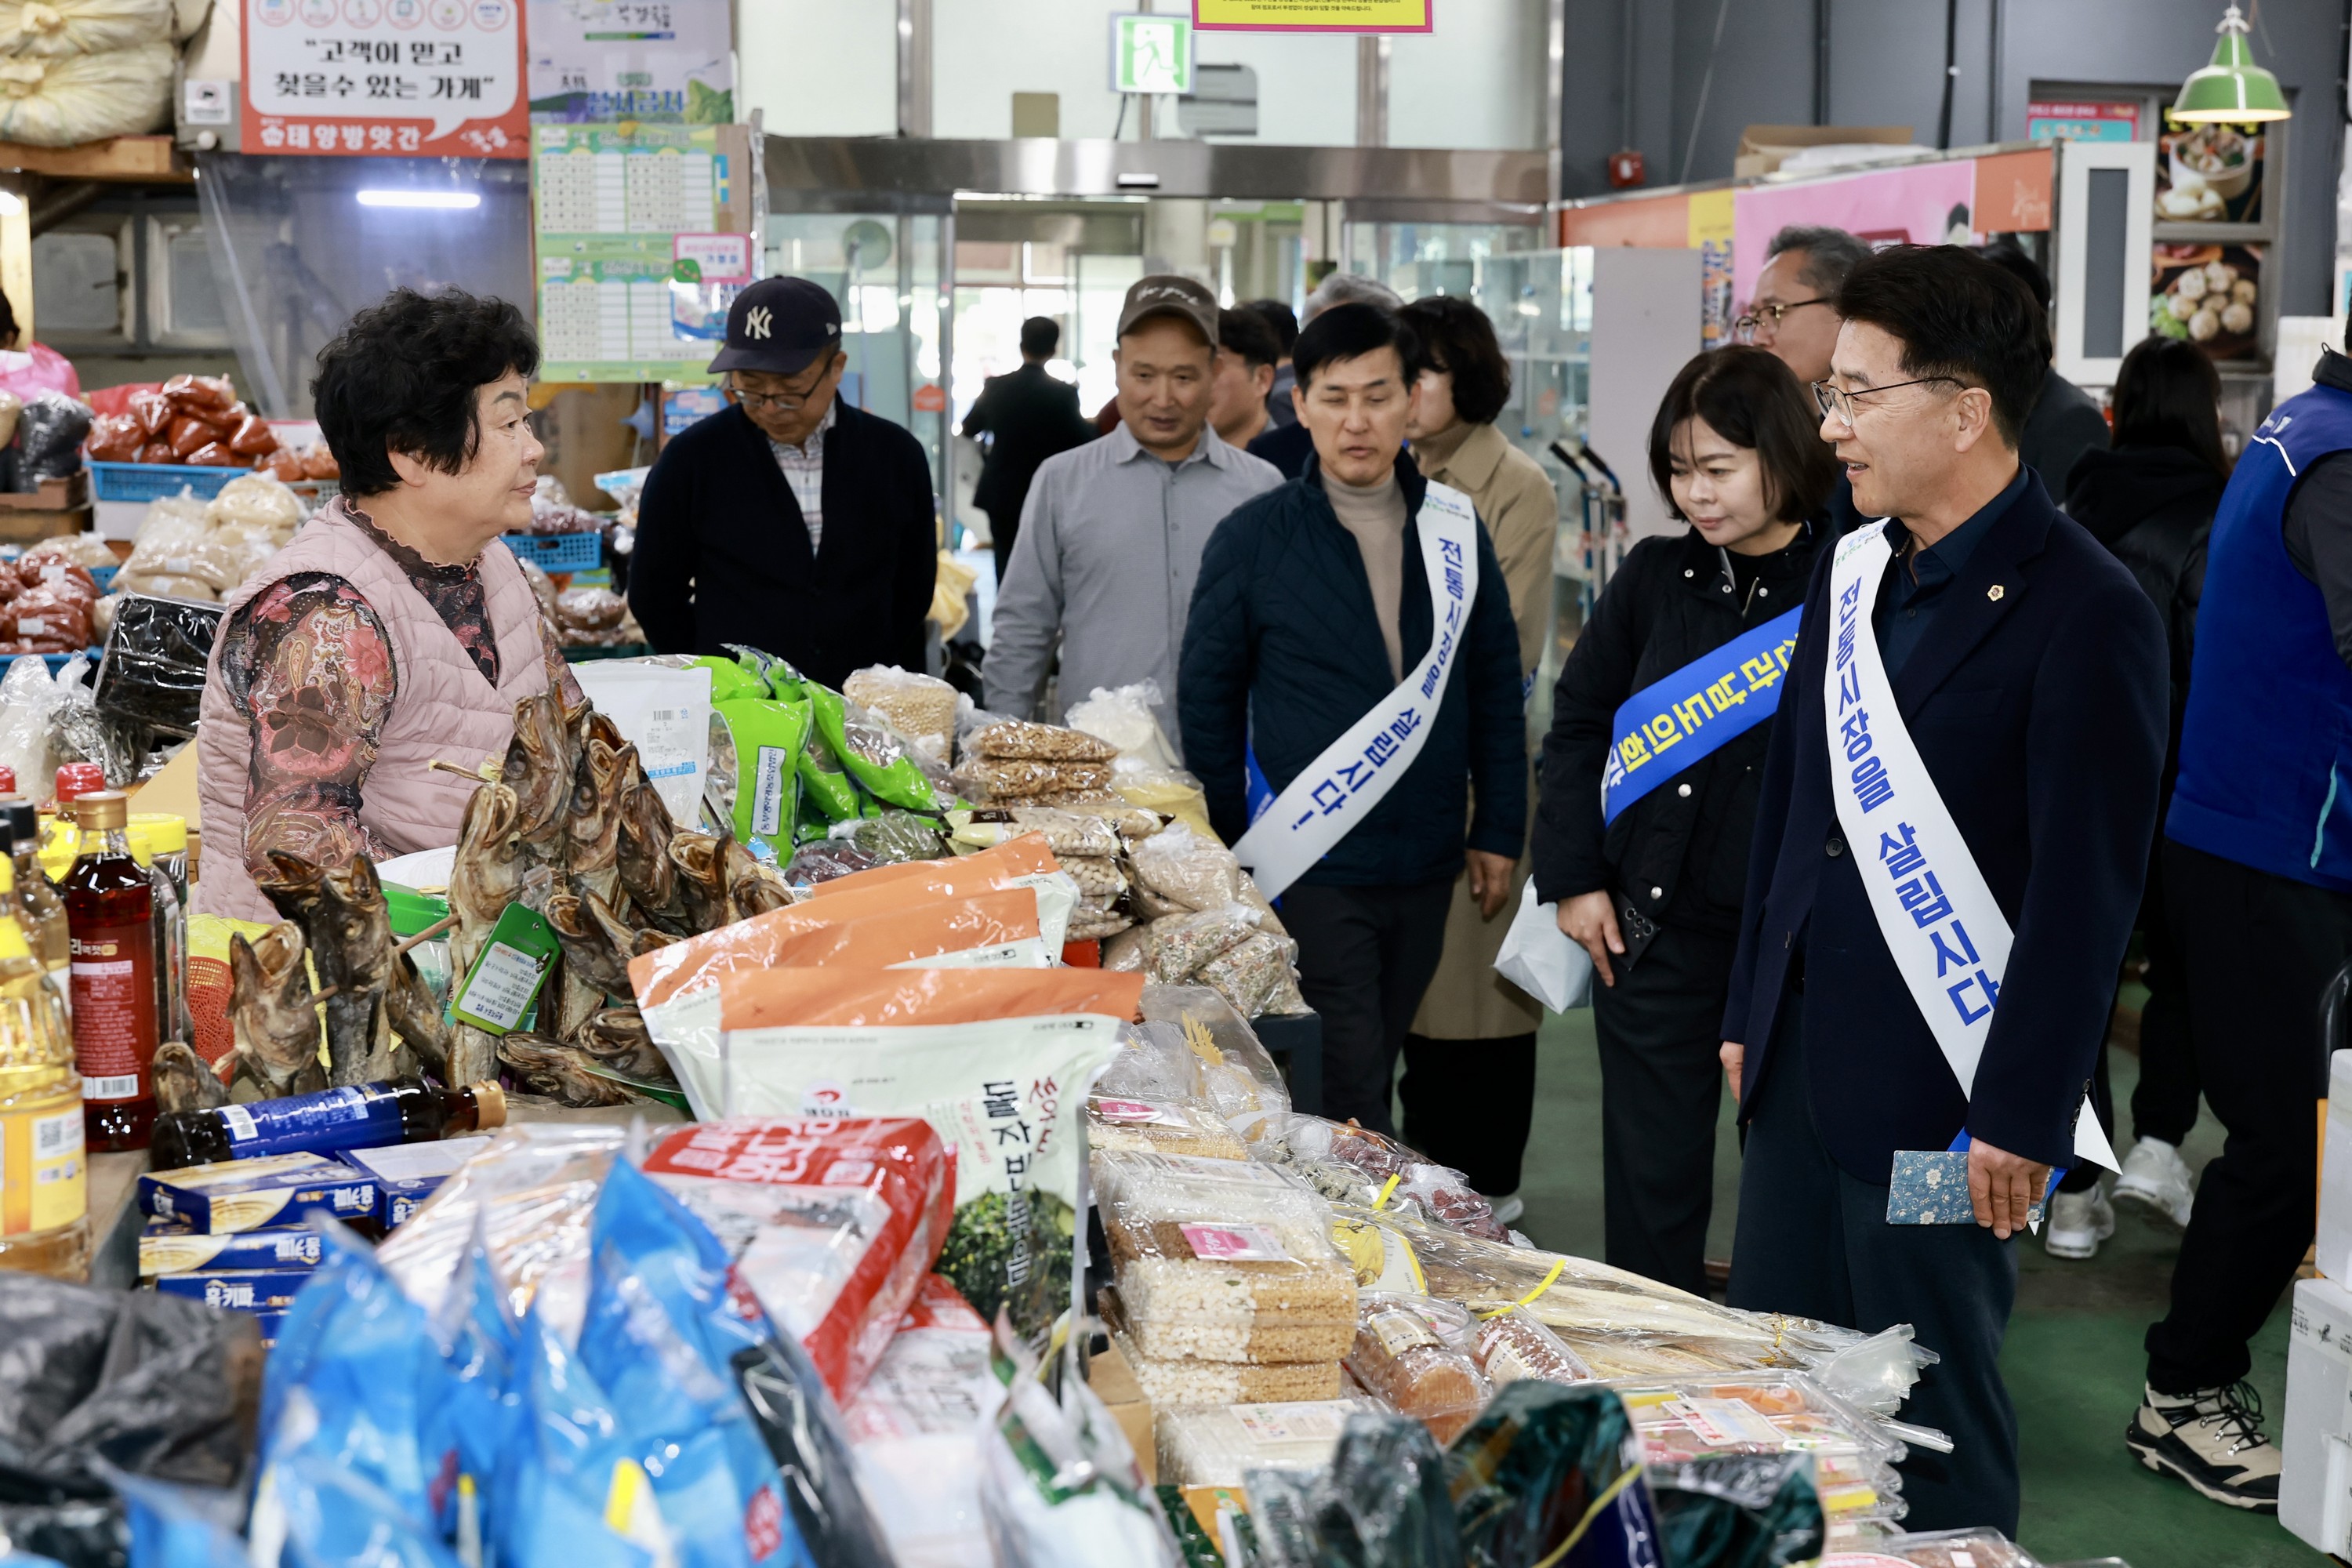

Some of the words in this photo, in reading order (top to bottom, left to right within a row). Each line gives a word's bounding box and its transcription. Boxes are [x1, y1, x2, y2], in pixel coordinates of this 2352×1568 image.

[274, 72, 355, 98] 찾을수
[365, 74, 419, 100] 있는
[410, 41, 463, 66] 믿고
[744, 305, 773, 340] NY
[1421, 537, 1464, 699] 전통시장을
[1291, 708, 1422, 832] 살립시다!
[1835, 575, 1895, 815] 전통시장을
[1878, 821, 2002, 1026] 살립시다
